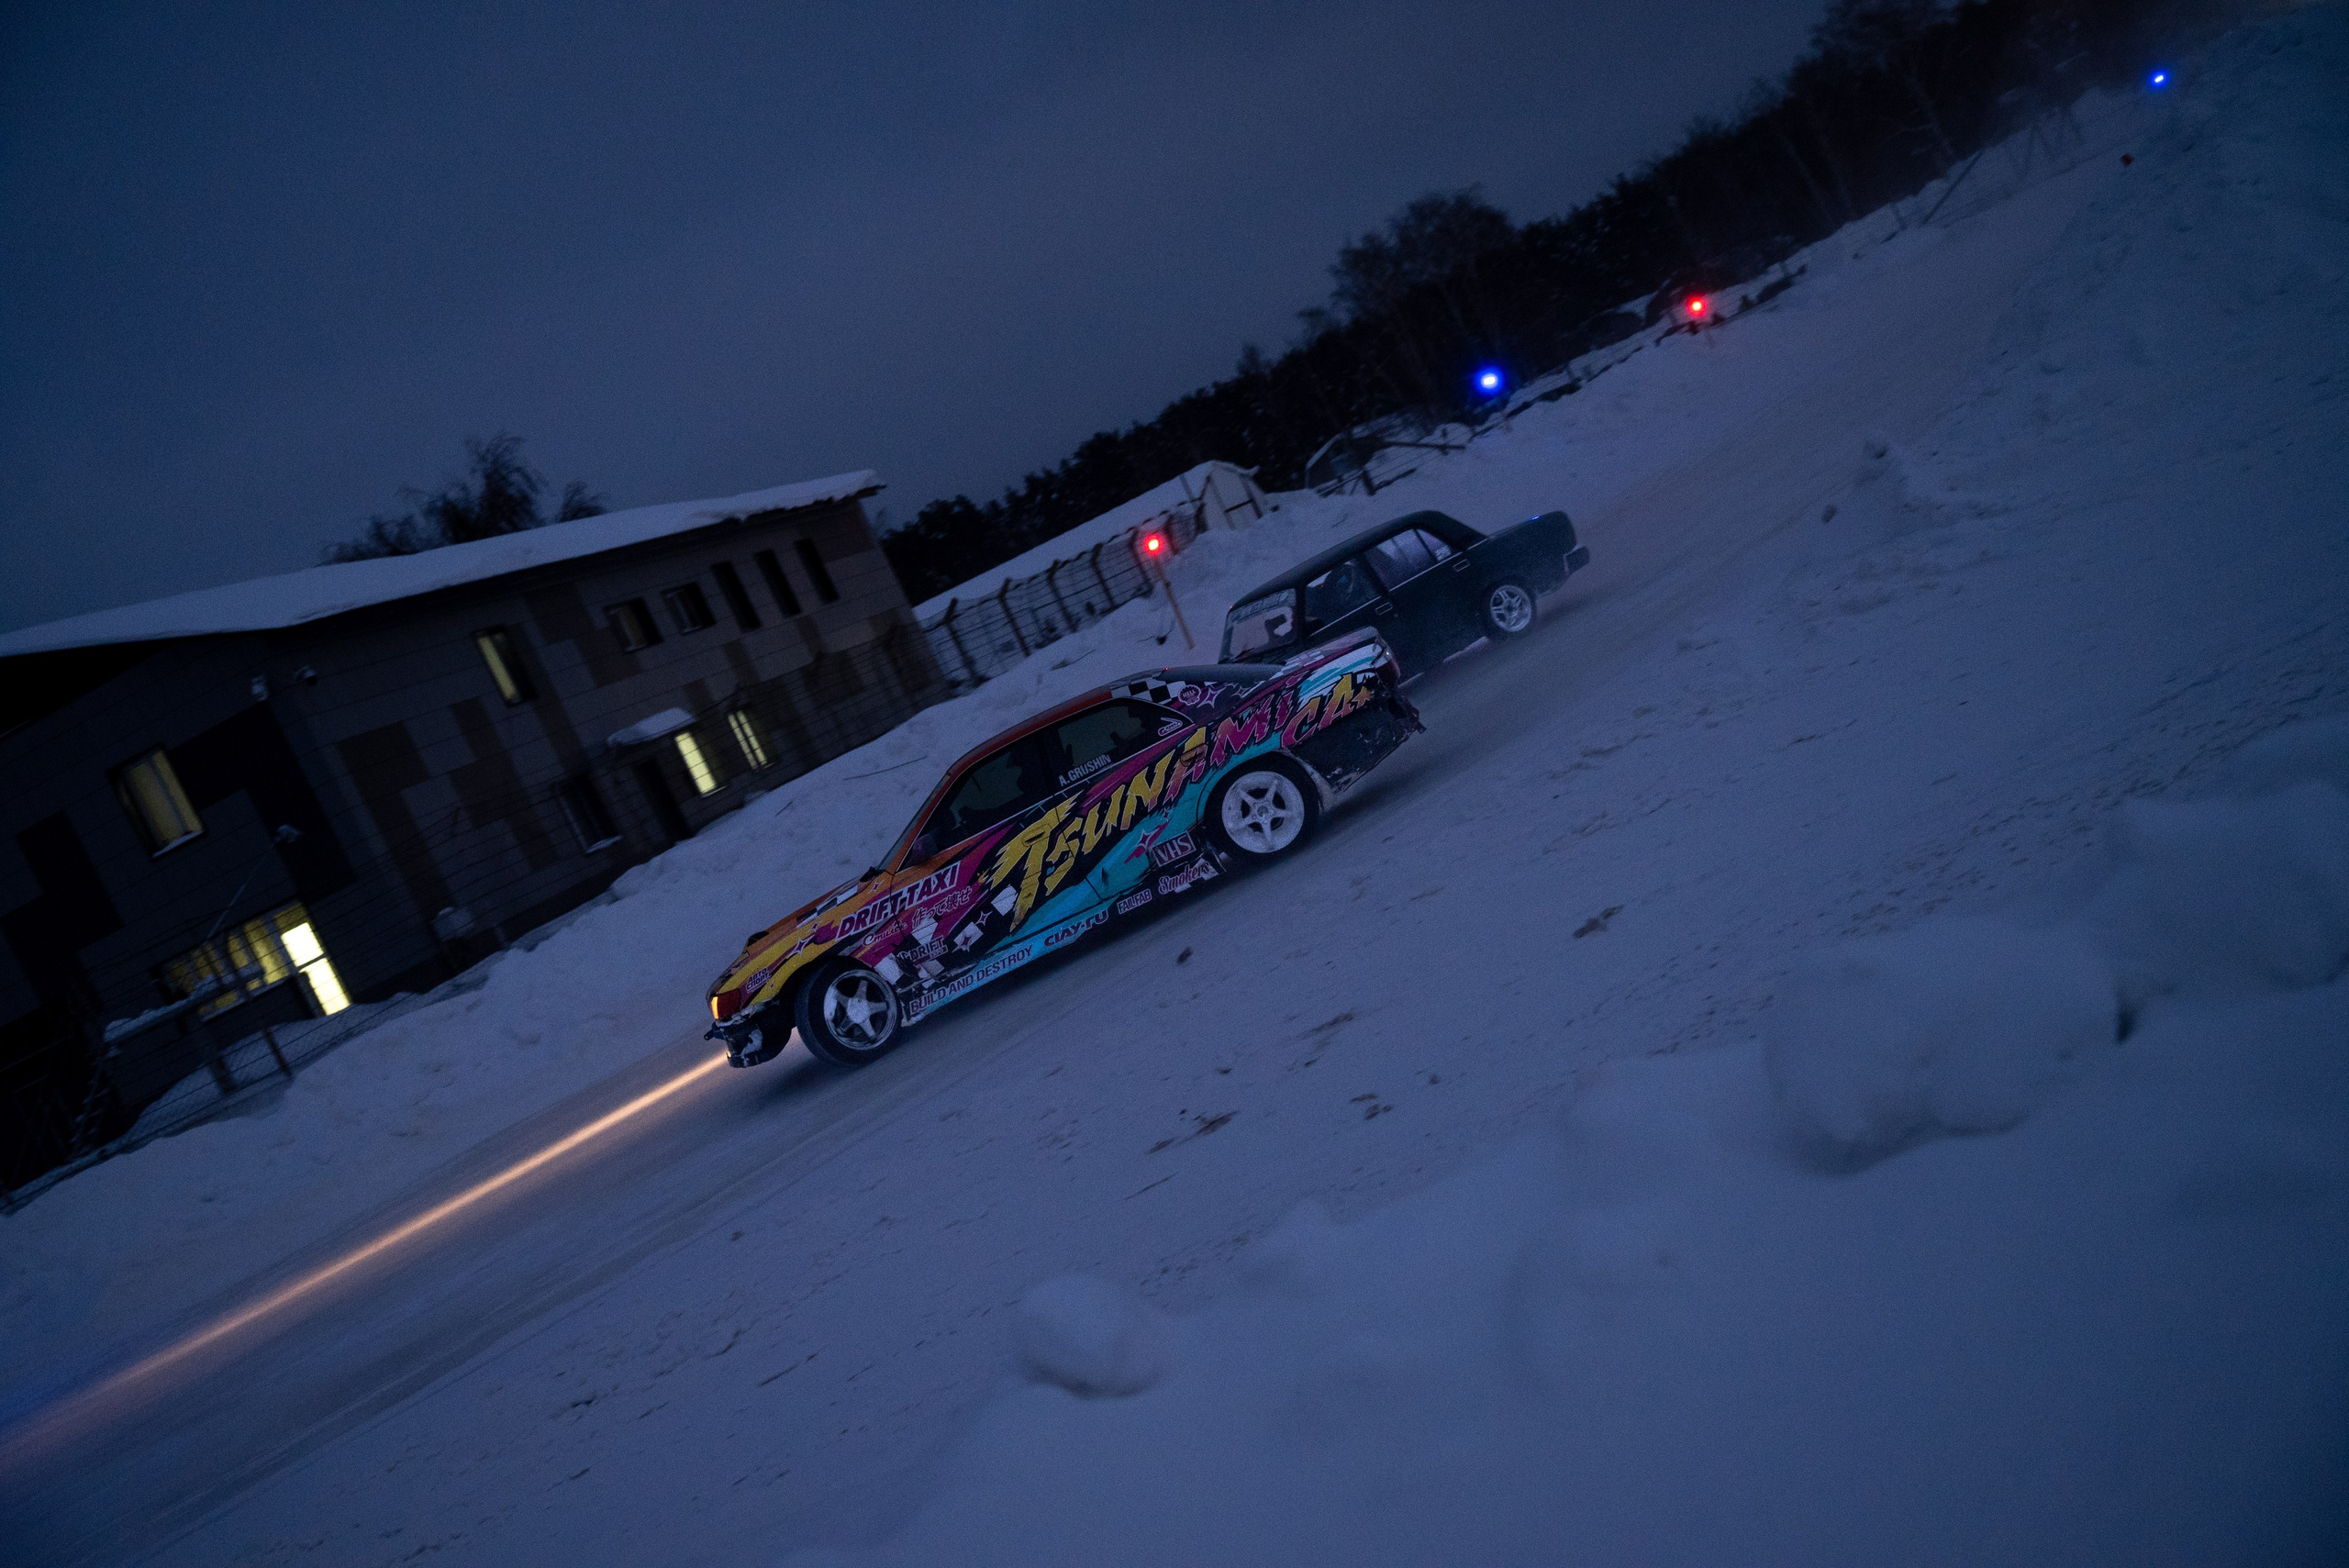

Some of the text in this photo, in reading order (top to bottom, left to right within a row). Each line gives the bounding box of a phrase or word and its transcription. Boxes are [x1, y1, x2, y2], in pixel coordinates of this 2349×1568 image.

[1155, 834, 1192, 862] VHS
[1158, 861, 1210, 895] Smokers
[835, 861, 961, 941] DRIFT-TAXI
[908, 935, 944, 962] DRIFT
[746, 973, 769, 990] СПОРТ
[748, 968, 767, 982] АВТО
[909, 944, 1033, 1015] BUILD AND DESTROY
